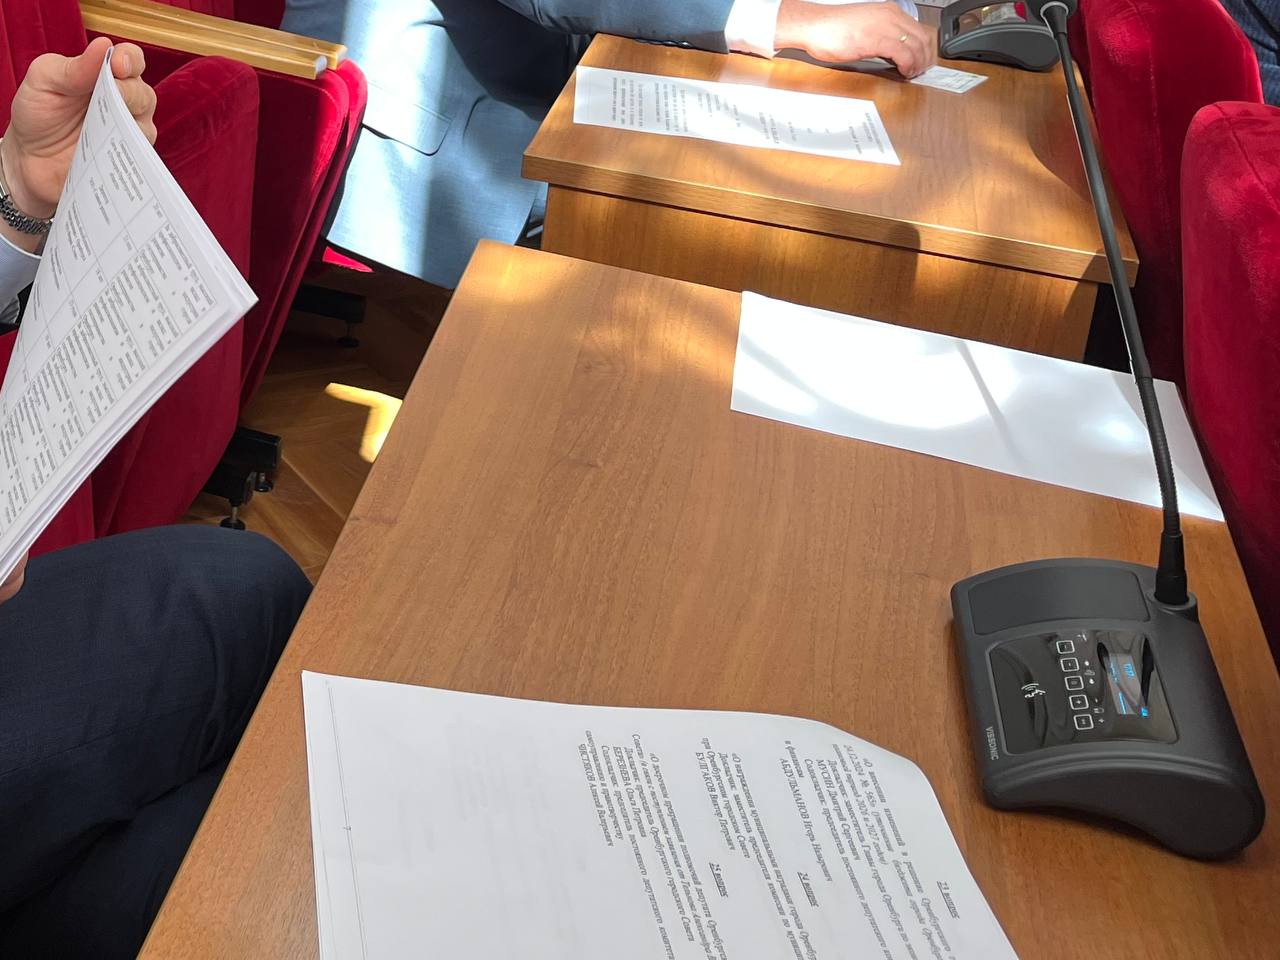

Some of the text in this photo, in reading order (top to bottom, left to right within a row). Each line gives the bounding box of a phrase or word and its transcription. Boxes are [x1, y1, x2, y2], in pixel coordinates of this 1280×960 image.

[784, 745, 805, 779] финансам
[985, 726, 999, 761] VISSONIC
[577, 744, 615, 847] ЧИСТЯКОВ Алексей Валерьевич
[600, 787, 624, 841] правотворчеству
[600, 744, 620, 788] Содокладчик:
[612, 789, 633, 832] председатель
[627, 833, 648, 876] постоянного
[642, 877, 664, 924] депутатского
[622, 746, 696, 942] Докладчик: председатель Оренбургского городского Совета
[625, 787, 637, 807] Ольга
[631, 806, 648, 839] Петровна
[631, 733, 645, 760] Совета»
[641, 767, 653, 787] связи
[676, 868, 686, 880] от
[691, 913, 714, 954] Александра
[651, 763, 670, 799] досрочном
[663, 799, 685, 843] прекращении
[679, 844, 703, 886] полномочий
[694, 886, 713, 918] депутата
[694, 751, 736, 851] БУЛГАКОВ Виктор Петрович
[700, 737, 751, 859] при Оренбургском городском Совете
[717, 752, 738, 791] Докладчик:
[732, 793, 753, 834] заместитель
[747, 835, 772, 881] председателя
[767, 882, 787, 917] комиссии
[781, 918, 791, 928] по
[734, 763, 756, 809] награждении
[749, 809, 779, 868] муниципальными
[773, 868, 795, 906] наградами
[788, 905, 804, 930] города
[779, 757, 810, 820] АБДУЛЬМАНОВ
[802, 820, 816, 843] Игорь
[815, 758, 861, 861] МУСИН Дмитрий Сергеевич
[845, 772, 863, 799] период
[855, 798, 871, 816] 2026
[864, 822, 880, 842] 2027
[708, 862, 729, 898] 25 вопрос
[796, 871, 820, 908] 24 вопрос
[803, 758, 828, 806] Содокладчик:
[821, 807, 846, 855] председатель
[840, 856, 866, 901] постоянного
[860, 901, 887, 948] депутатского
[826, 759, 849, 799] Докладчик:
[843, 799, 866, 844] заместитель
[860, 844, 876, 868] Главы
[870, 868, 887, 894] города
[882, 893, 905, 933] Оренбурга
[899, 932, 909, 943] по
[859, 778, 871, 789] №
[909, 898, 926, 925] города
[867, 770, 887, 804] внесении
[883, 807, 906, 847] изменений
[902, 861, 924, 894] решение
[920, 897, 952, 953] Оренбургского
[936, 880, 961, 919] 23 вопрос
